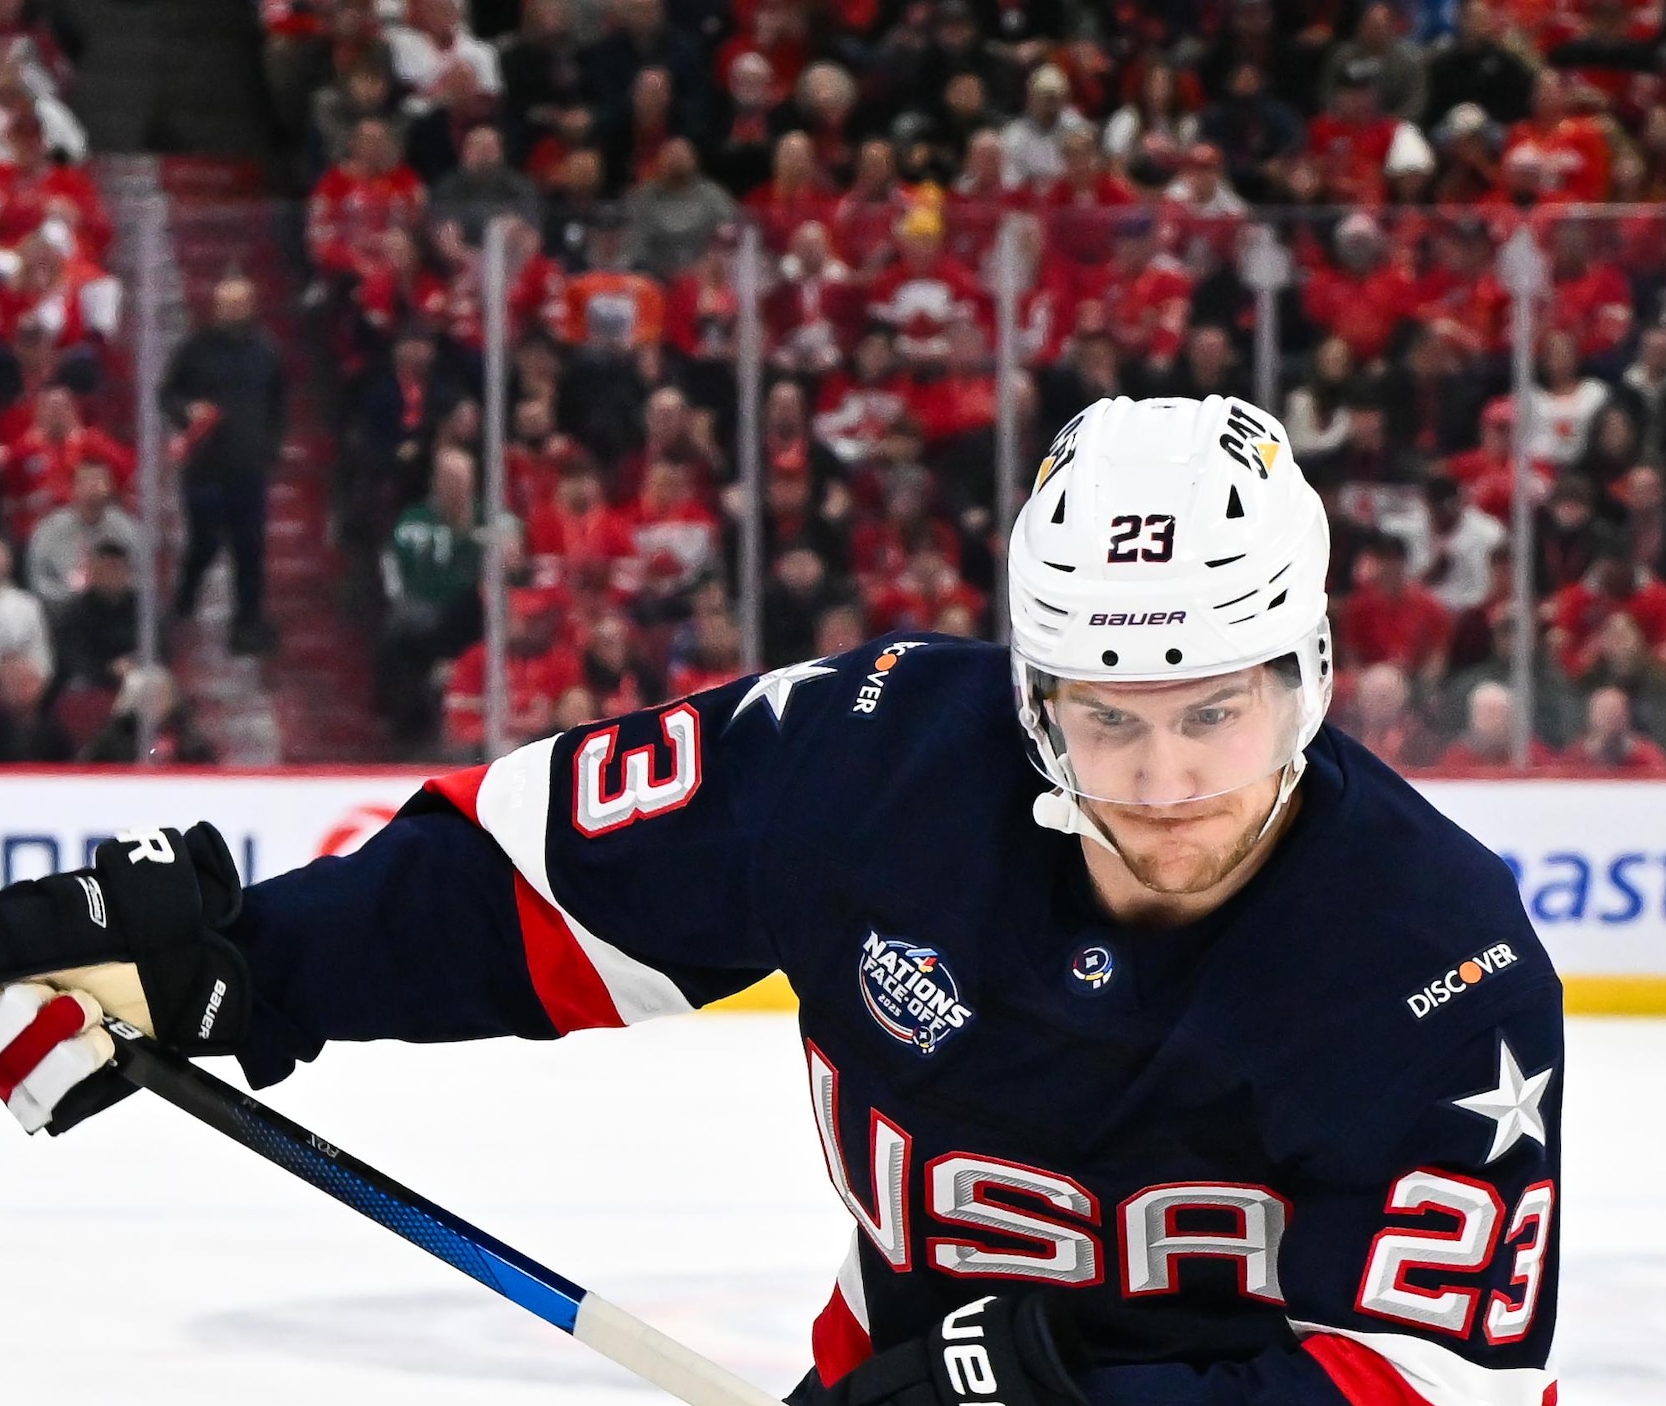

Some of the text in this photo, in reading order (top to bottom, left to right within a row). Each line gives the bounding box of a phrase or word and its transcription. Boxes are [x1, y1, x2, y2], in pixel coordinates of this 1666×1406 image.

[1107, 514, 1176, 563] 23
[863, 930, 973, 1028] NATIONS
[1406, 942, 1518, 1019] DISCOVER
[807, 1037, 1293, 1307] USA
[1353, 1165, 1556, 1346] 23
